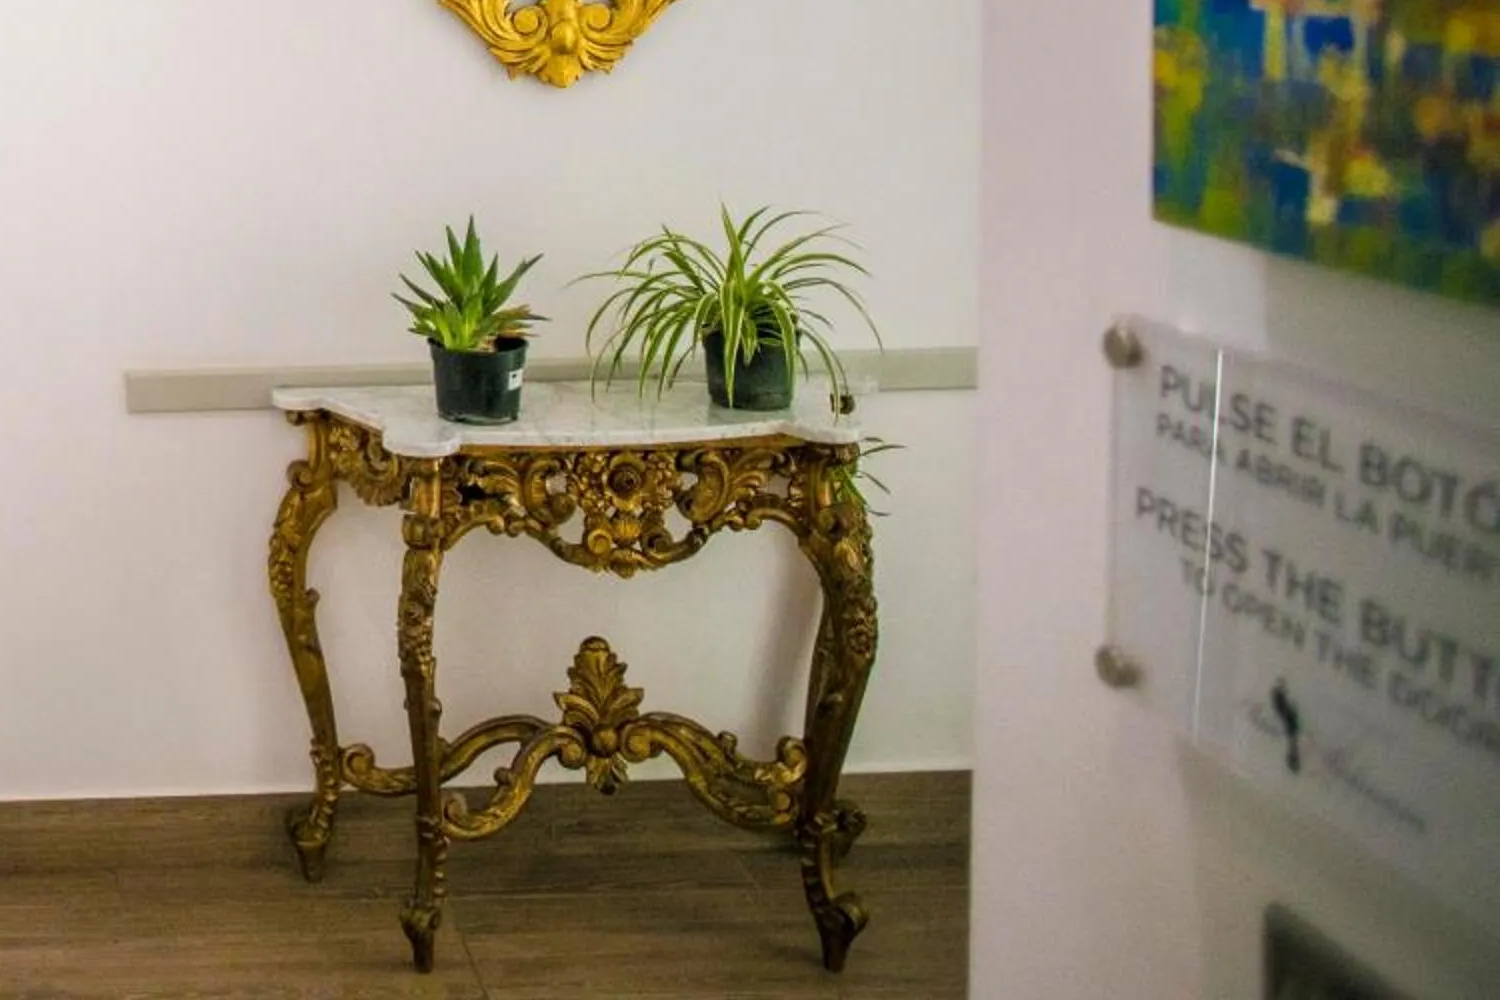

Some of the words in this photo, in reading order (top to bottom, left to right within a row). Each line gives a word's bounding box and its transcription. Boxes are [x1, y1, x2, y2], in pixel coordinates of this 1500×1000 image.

[1155, 412, 1226, 467] PARA
[1234, 447, 1325, 511] ABRIR
[1333, 490, 1380, 535] LA
[1159, 363, 1278, 447] PULSE
[1290, 414, 1345, 475] EL
[1135, 486, 1248, 575] PRESS
[1261, 548, 1343, 625] THE
[1359, 598, 1500, 708] BUTT
[1180, 556, 1216, 597] TO
[1221, 582, 1306, 652] OPEN
[1314, 628, 1377, 691] THE
